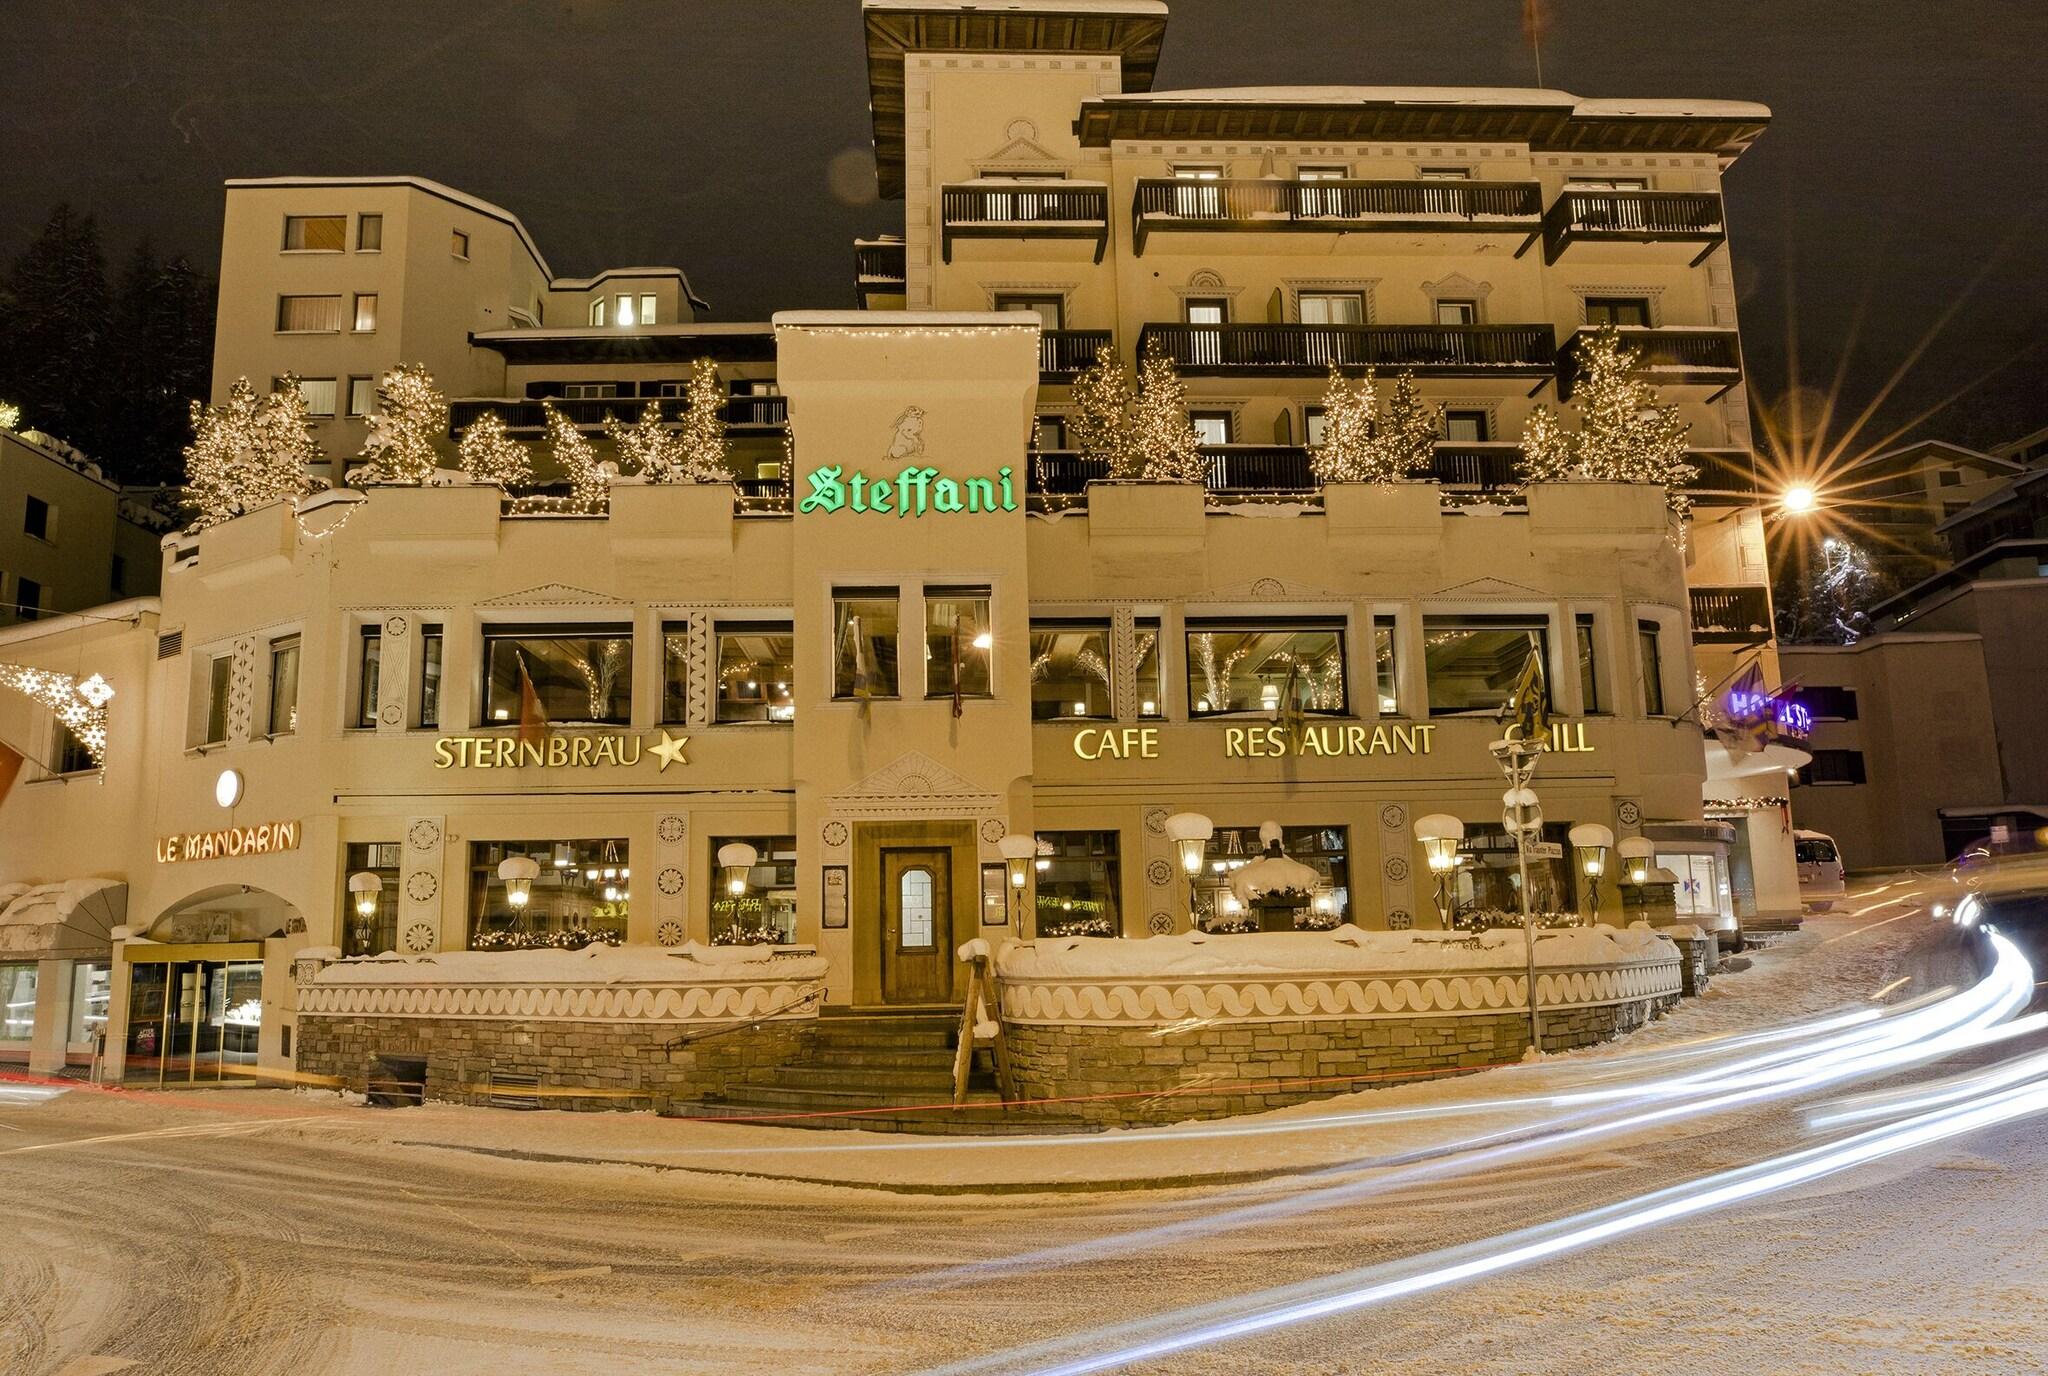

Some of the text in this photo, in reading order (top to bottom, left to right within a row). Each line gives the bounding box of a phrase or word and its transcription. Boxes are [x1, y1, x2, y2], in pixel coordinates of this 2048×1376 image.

[800, 464, 1018, 518] Steffani
[1731, 693, 1794, 724] HOL
[434, 735, 641, 769] STERNBRÄU
[1074, 722, 1595, 760] CAFE RESAURANT ILL
[156, 822, 295, 863] LE MANDARIN
